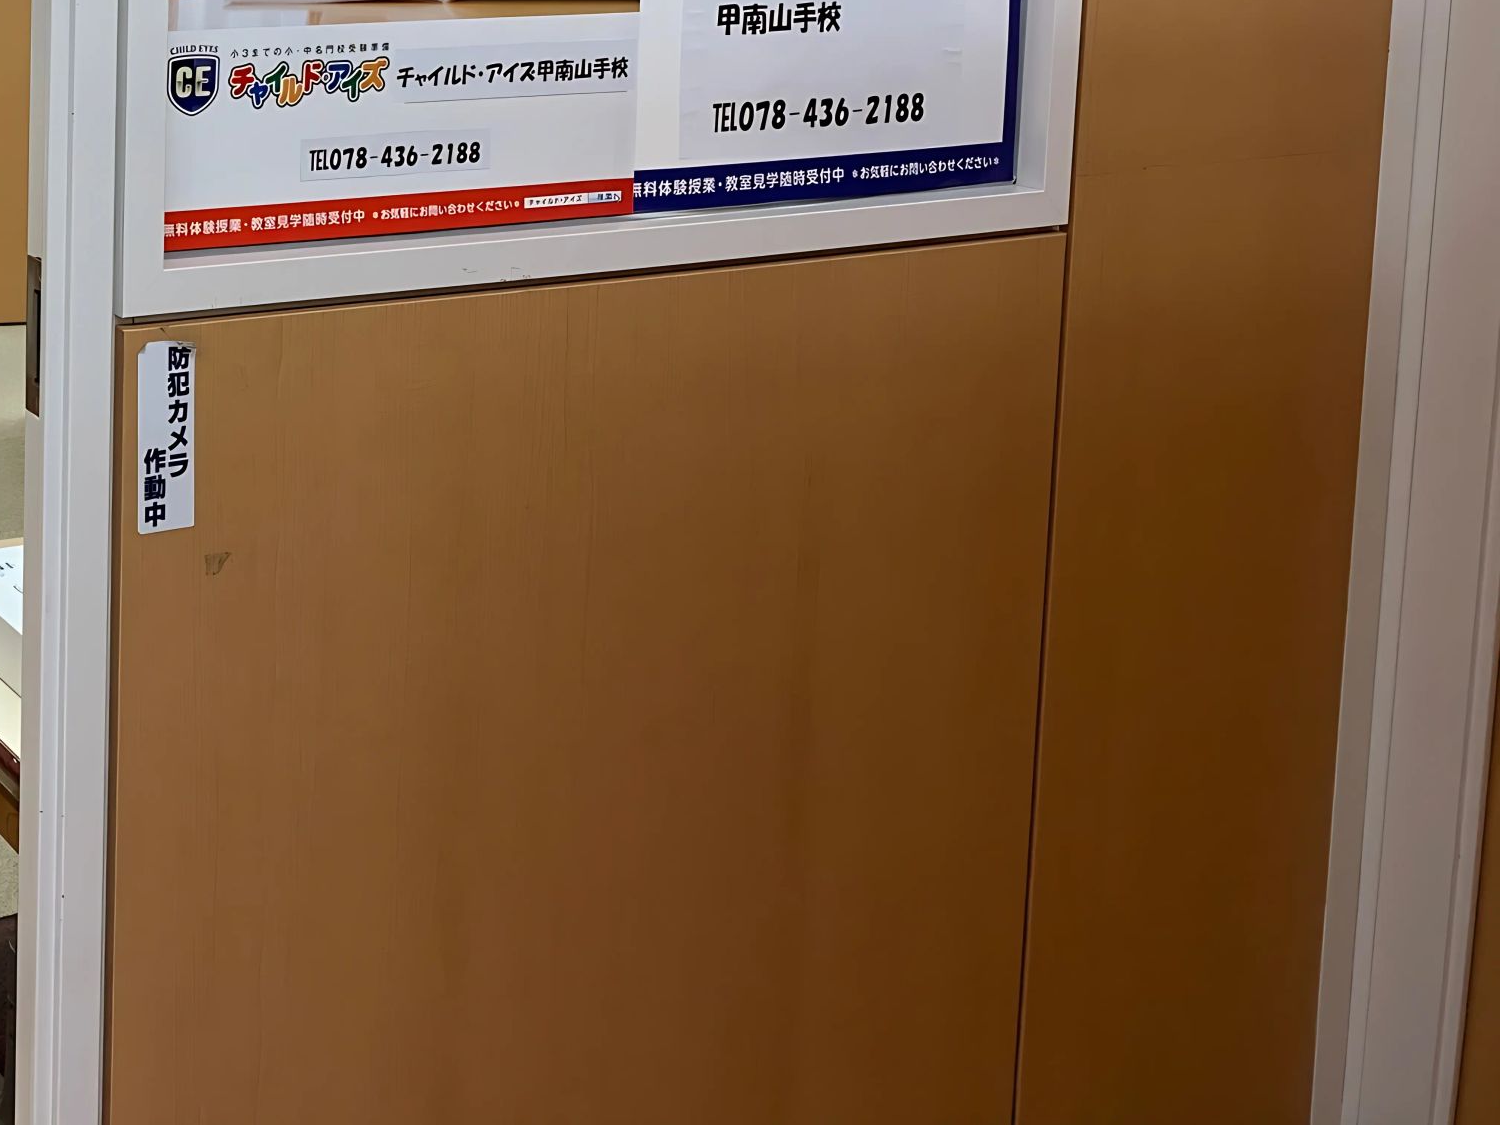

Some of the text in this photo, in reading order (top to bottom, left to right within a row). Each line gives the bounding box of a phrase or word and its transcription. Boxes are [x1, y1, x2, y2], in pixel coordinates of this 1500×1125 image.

[716, 1, 842, 36] 甲南山手校
[174, 65, 212, 99] CE
[396, 56, 629, 88] チャイルド・アイズ甲南山手校
[167, 346, 191, 477] 防犯カメラ
[143, 447, 167, 527] 作動中
